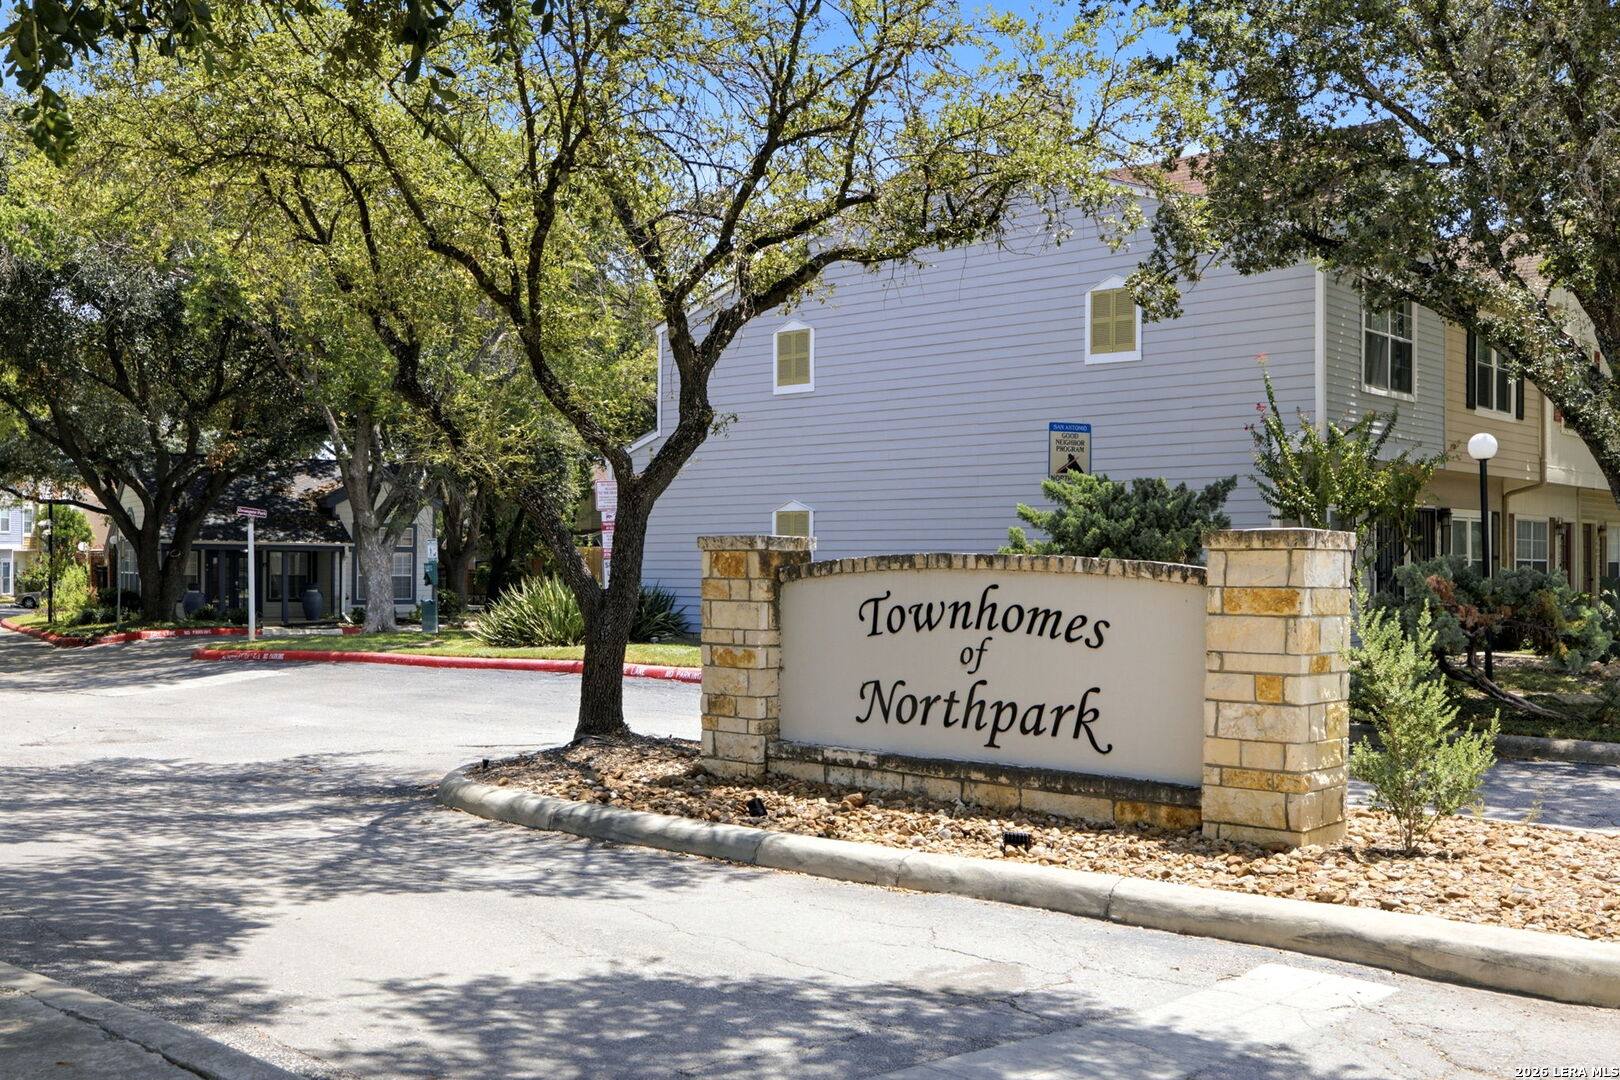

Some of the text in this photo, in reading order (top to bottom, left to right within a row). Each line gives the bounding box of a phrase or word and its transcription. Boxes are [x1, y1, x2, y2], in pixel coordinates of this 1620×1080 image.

[1061, 432, 1079, 440] GOOD
[858, 584, 1110, 649] Townhomes
[664, 669, 675, 678] NO
[959, 637, 993, 674] of
[855, 679, 1113, 755] Northpark
